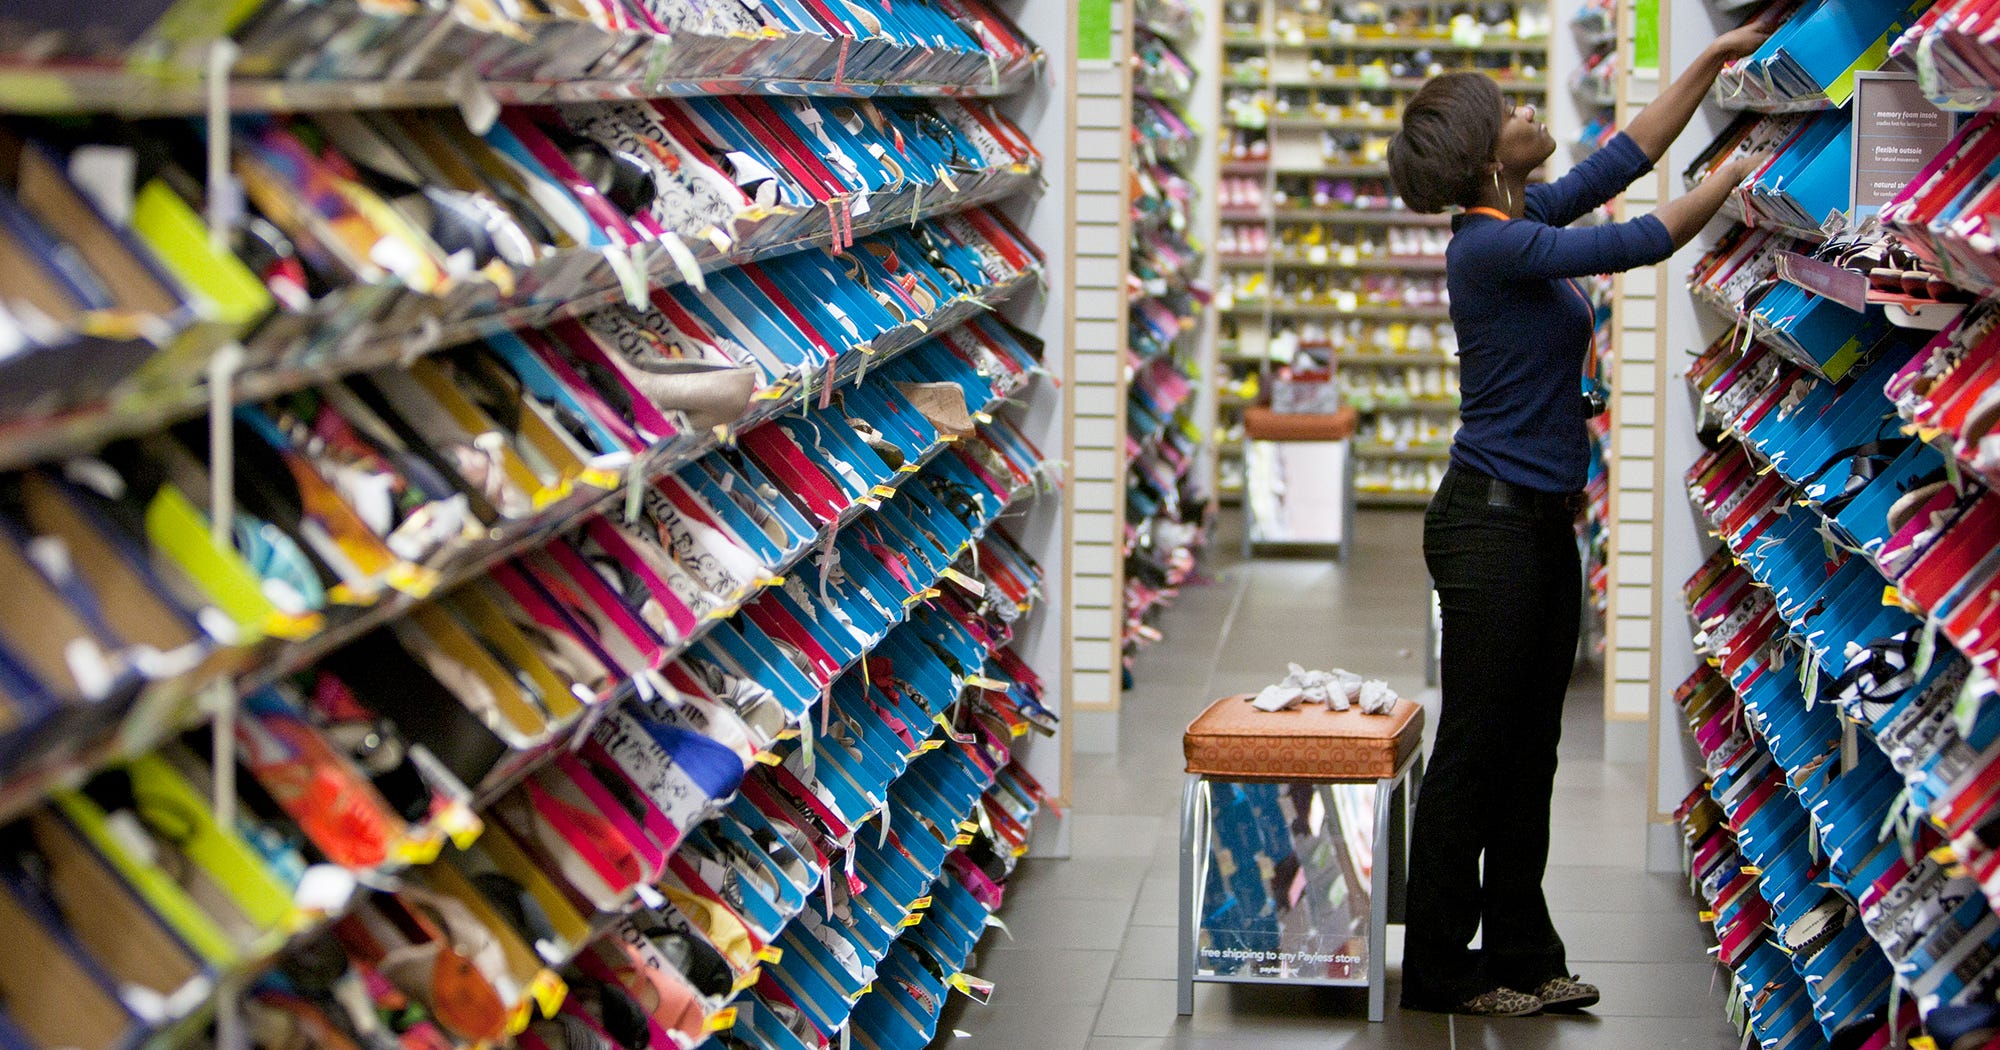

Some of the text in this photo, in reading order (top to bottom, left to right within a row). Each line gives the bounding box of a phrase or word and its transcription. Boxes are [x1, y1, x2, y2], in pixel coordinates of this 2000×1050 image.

[1876, 111, 1901, 120] memory
[1902, 111, 1919, 120] foam
[1875, 146, 1898, 155] flexible
[1201, 947, 1361, 965] free shipping to any Payless store
